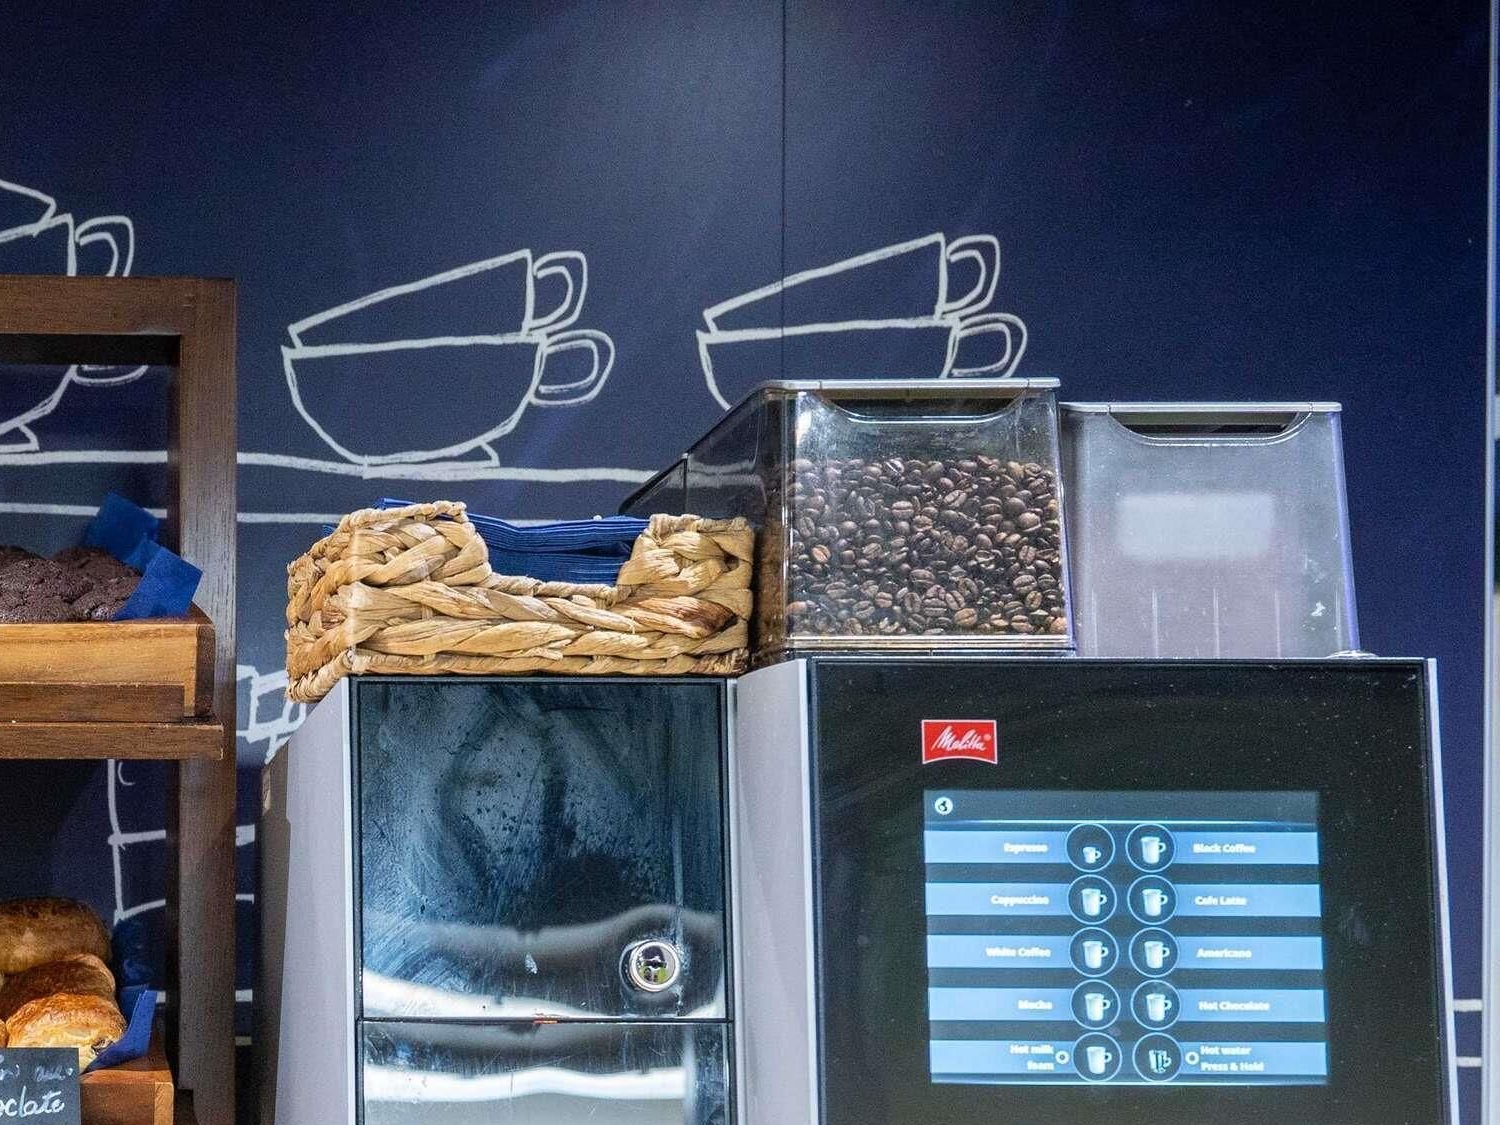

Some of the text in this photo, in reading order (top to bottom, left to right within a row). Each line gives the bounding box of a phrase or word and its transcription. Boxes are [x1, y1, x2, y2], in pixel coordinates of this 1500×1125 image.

[931, 725, 988, 751] Melitta
[1003, 842, 1049, 855] Espresso
[990, 894, 1050, 907] Cappuccino
[1197, 948, 1252, 959] Americano
[1199, 1001, 1270, 1012] Hot Chocolate
[1010, 1044, 1054, 1055] Hot milk
[1200, 1045, 1252, 1056] Hot water
[1027, 1060, 1054, 1071] foam
[1201, 1061, 1265, 1072] Press & Hold
